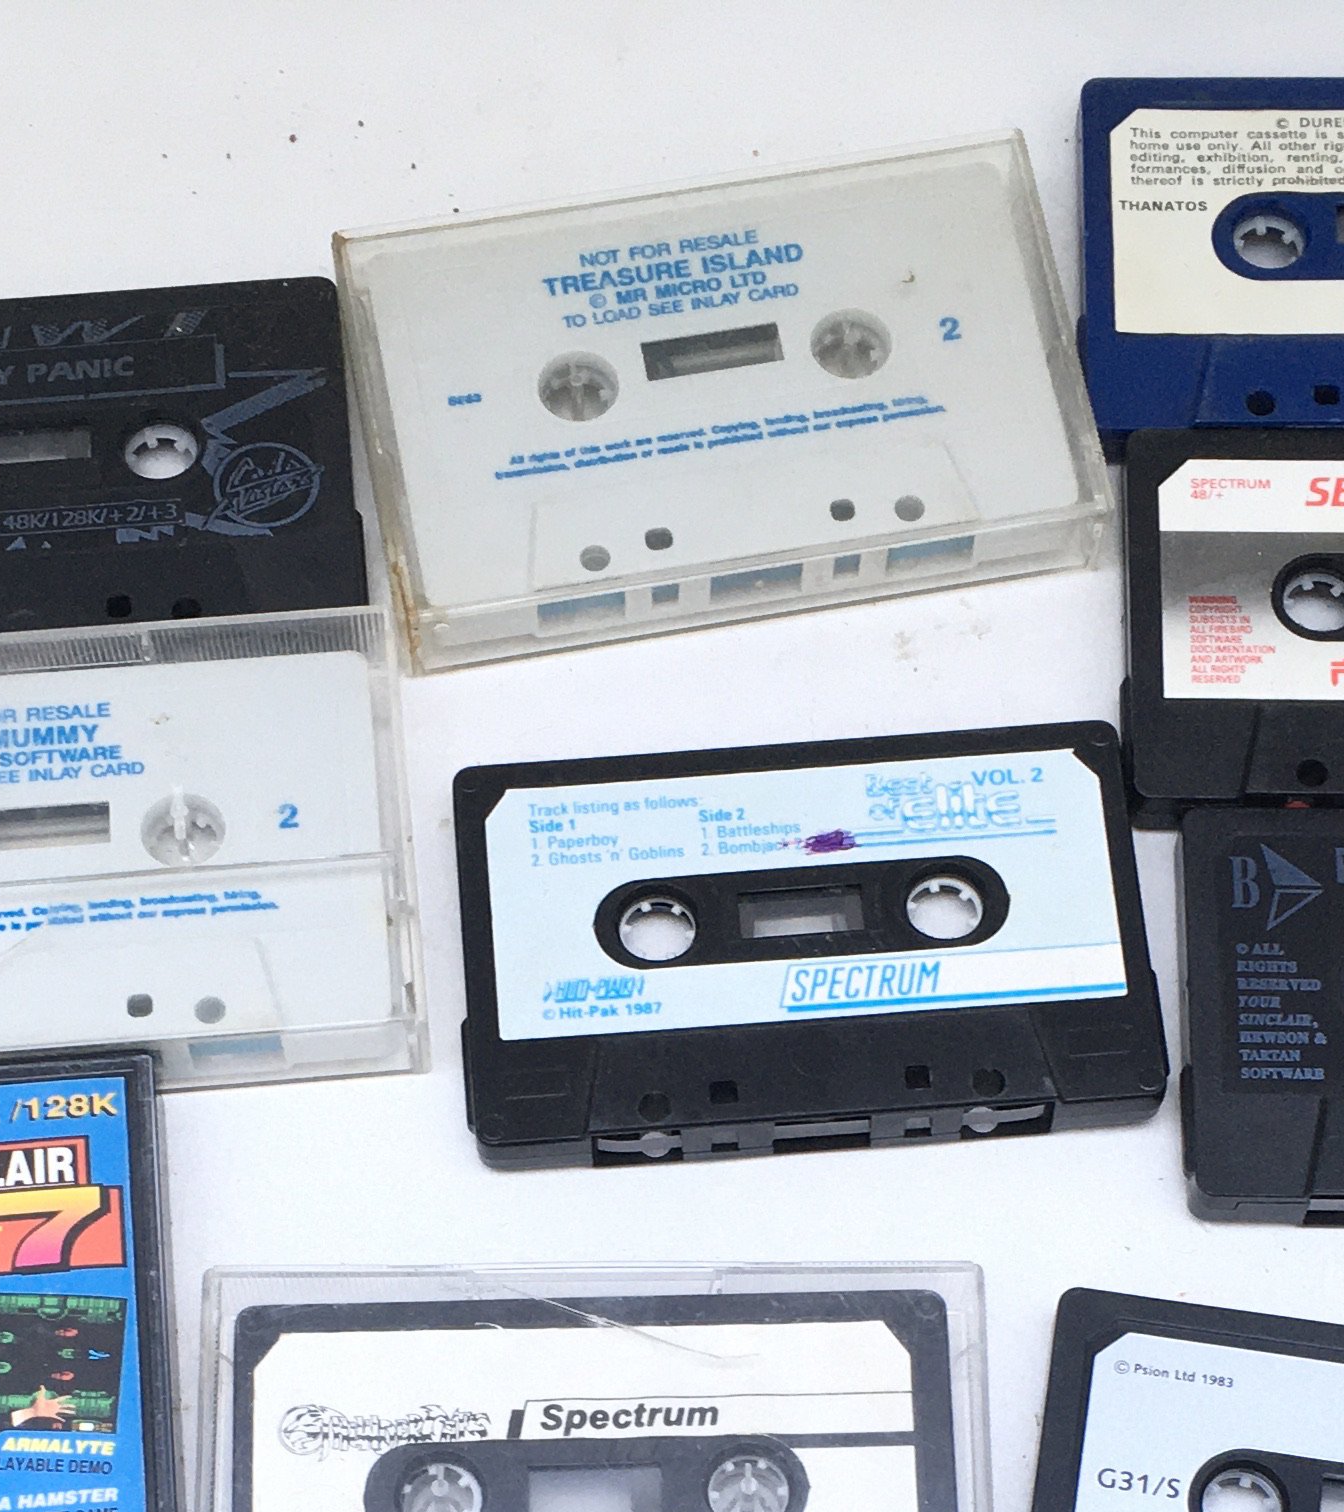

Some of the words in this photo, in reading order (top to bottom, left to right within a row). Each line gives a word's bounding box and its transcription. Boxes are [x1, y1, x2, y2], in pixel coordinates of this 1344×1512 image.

[1131, 175, 1181, 186] thereof
[1191, 175, 1204, 186] is
[1213, 175, 1264, 188] strictly
[1120, 201, 1207, 211] THANATOS
[579, 249, 620, 268] NOT
[628, 241, 672, 261] FOR
[679, 229, 759, 255] RESALE
[542, 262, 693, 297] TREASURE
[701, 242, 804, 273] ISLAND
[615, 287, 649, 305] MR
[655, 276, 722, 299] MICRO
[729, 269, 767, 290] LTD
[939, 316, 962, 340] 2
[27, 356, 134, 383] PANIC
[1190, 479, 1270, 489] SPECTRUM
[972, 769, 1022, 786] VOL.
[1030, 767, 1043, 783] 2
[279, 802, 299, 829] 2
[529, 820, 561, 833] Side
[568, 820, 576, 832] 1
[699, 810, 730, 823] Side
[735, 809, 745, 821] 2
[548, 833, 618, 852] Paperboy
[791, 962, 940, 1000] SPECTRUM
[559, 1004, 618, 1020] Hit-Pak
[625, 1002, 661, 1016] 1987
[1133, 1364, 1169, 1379] Psion
[1174, 1369, 1196, 1382] Ltd
[1201, 1374, 1234, 1387] 1983
[540, 1402, 719, 1432] Spectrum
[1097, 1469, 1181, 1499] G31/S
[18, 1487, 118, 1509] HAMSTER
